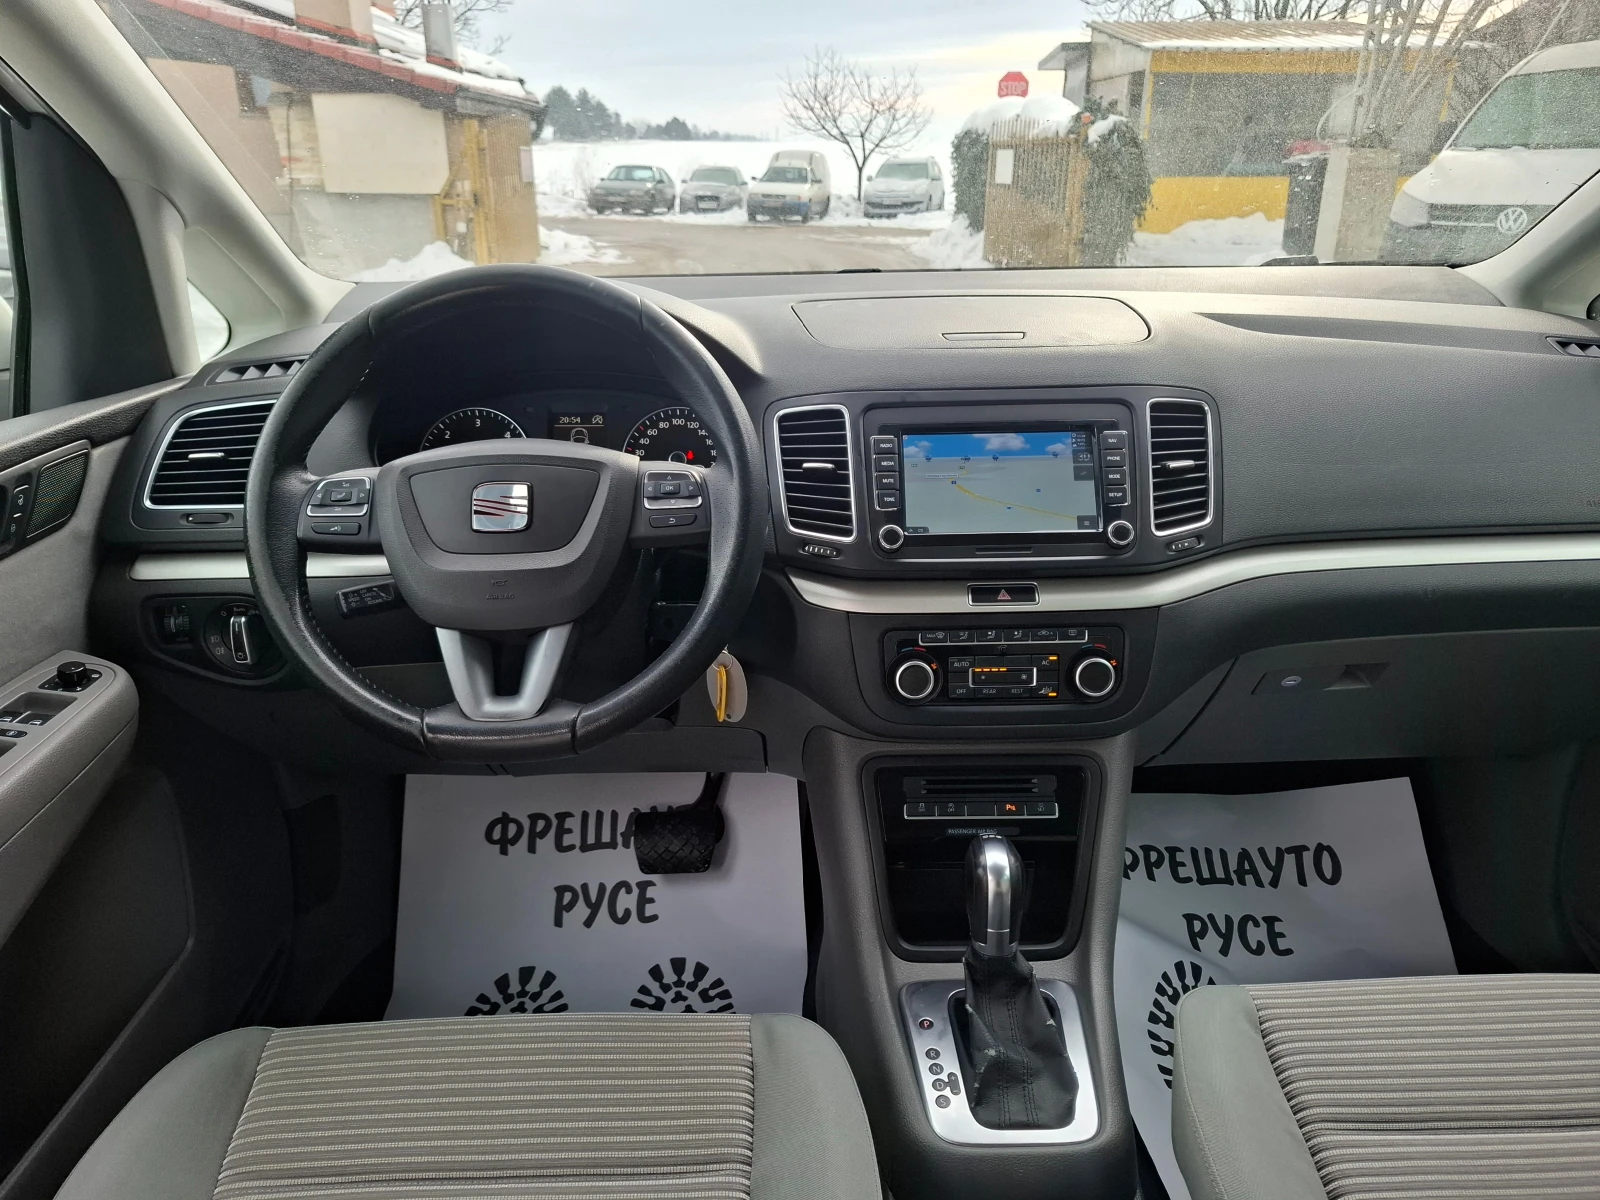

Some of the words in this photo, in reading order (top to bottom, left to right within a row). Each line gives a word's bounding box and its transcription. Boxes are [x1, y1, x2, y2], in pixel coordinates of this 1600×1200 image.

[999, 81, 1027, 96] STOP
[474, 417, 481, 428] 3
[559, 415, 581, 424] 20:54
[671, 418, 685, 426] 100
[658, 421, 670, 429] 80
[686, 421, 700, 429] 120
[444, 430, 451, 439] 2
[504, 430, 512, 439] 4
[647, 428, 658, 436] 60
[639, 437, 650, 445] 40
[705, 438, 714, 446] 16
[1077, 451, 1091, 461] 3D
[953, 660, 970, 668] AUTO
[484, 806, 668, 856] ФРЕША
[553, 880, 660, 929] РУСЕ
[1182, 912, 1294, 958] РУСЕ
[924, 1020, 930, 1028] P
[930, 1050, 937, 1058] R
[932, 1065, 941, 1073] N
[936, 1082, 944, 1090] D
[939, 1098, 946, 1106] S
